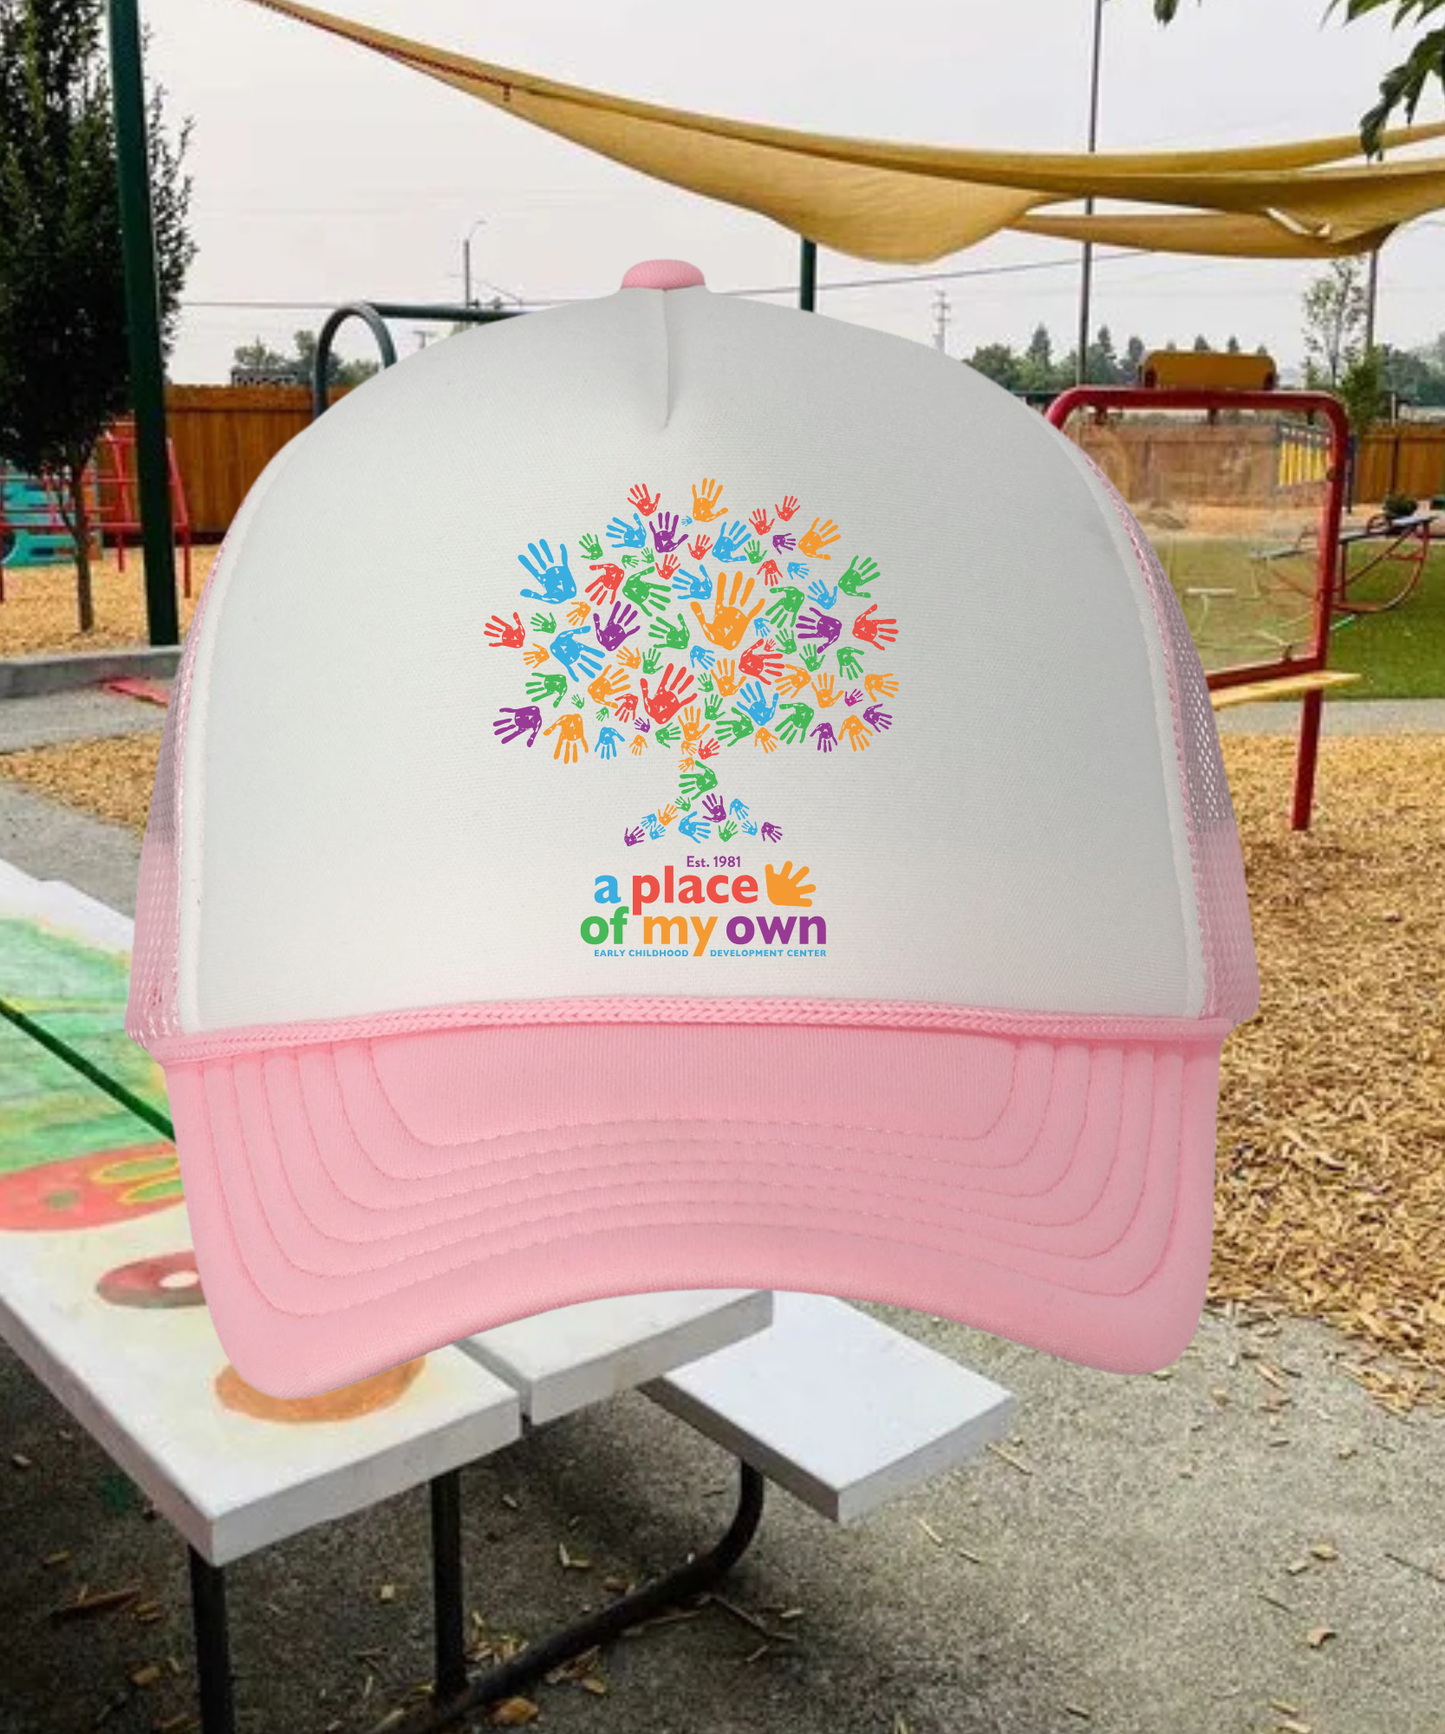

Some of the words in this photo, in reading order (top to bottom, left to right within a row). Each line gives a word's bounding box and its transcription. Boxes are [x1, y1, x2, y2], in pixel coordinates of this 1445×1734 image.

[687, 856, 709, 867] Est.
[714, 856, 740, 867] 1981
[594, 875, 621, 904] a
[632, 865, 758, 915] place
[580, 906, 629, 944] of
[643, 916, 718, 957] my
[726, 916, 826, 944] own
